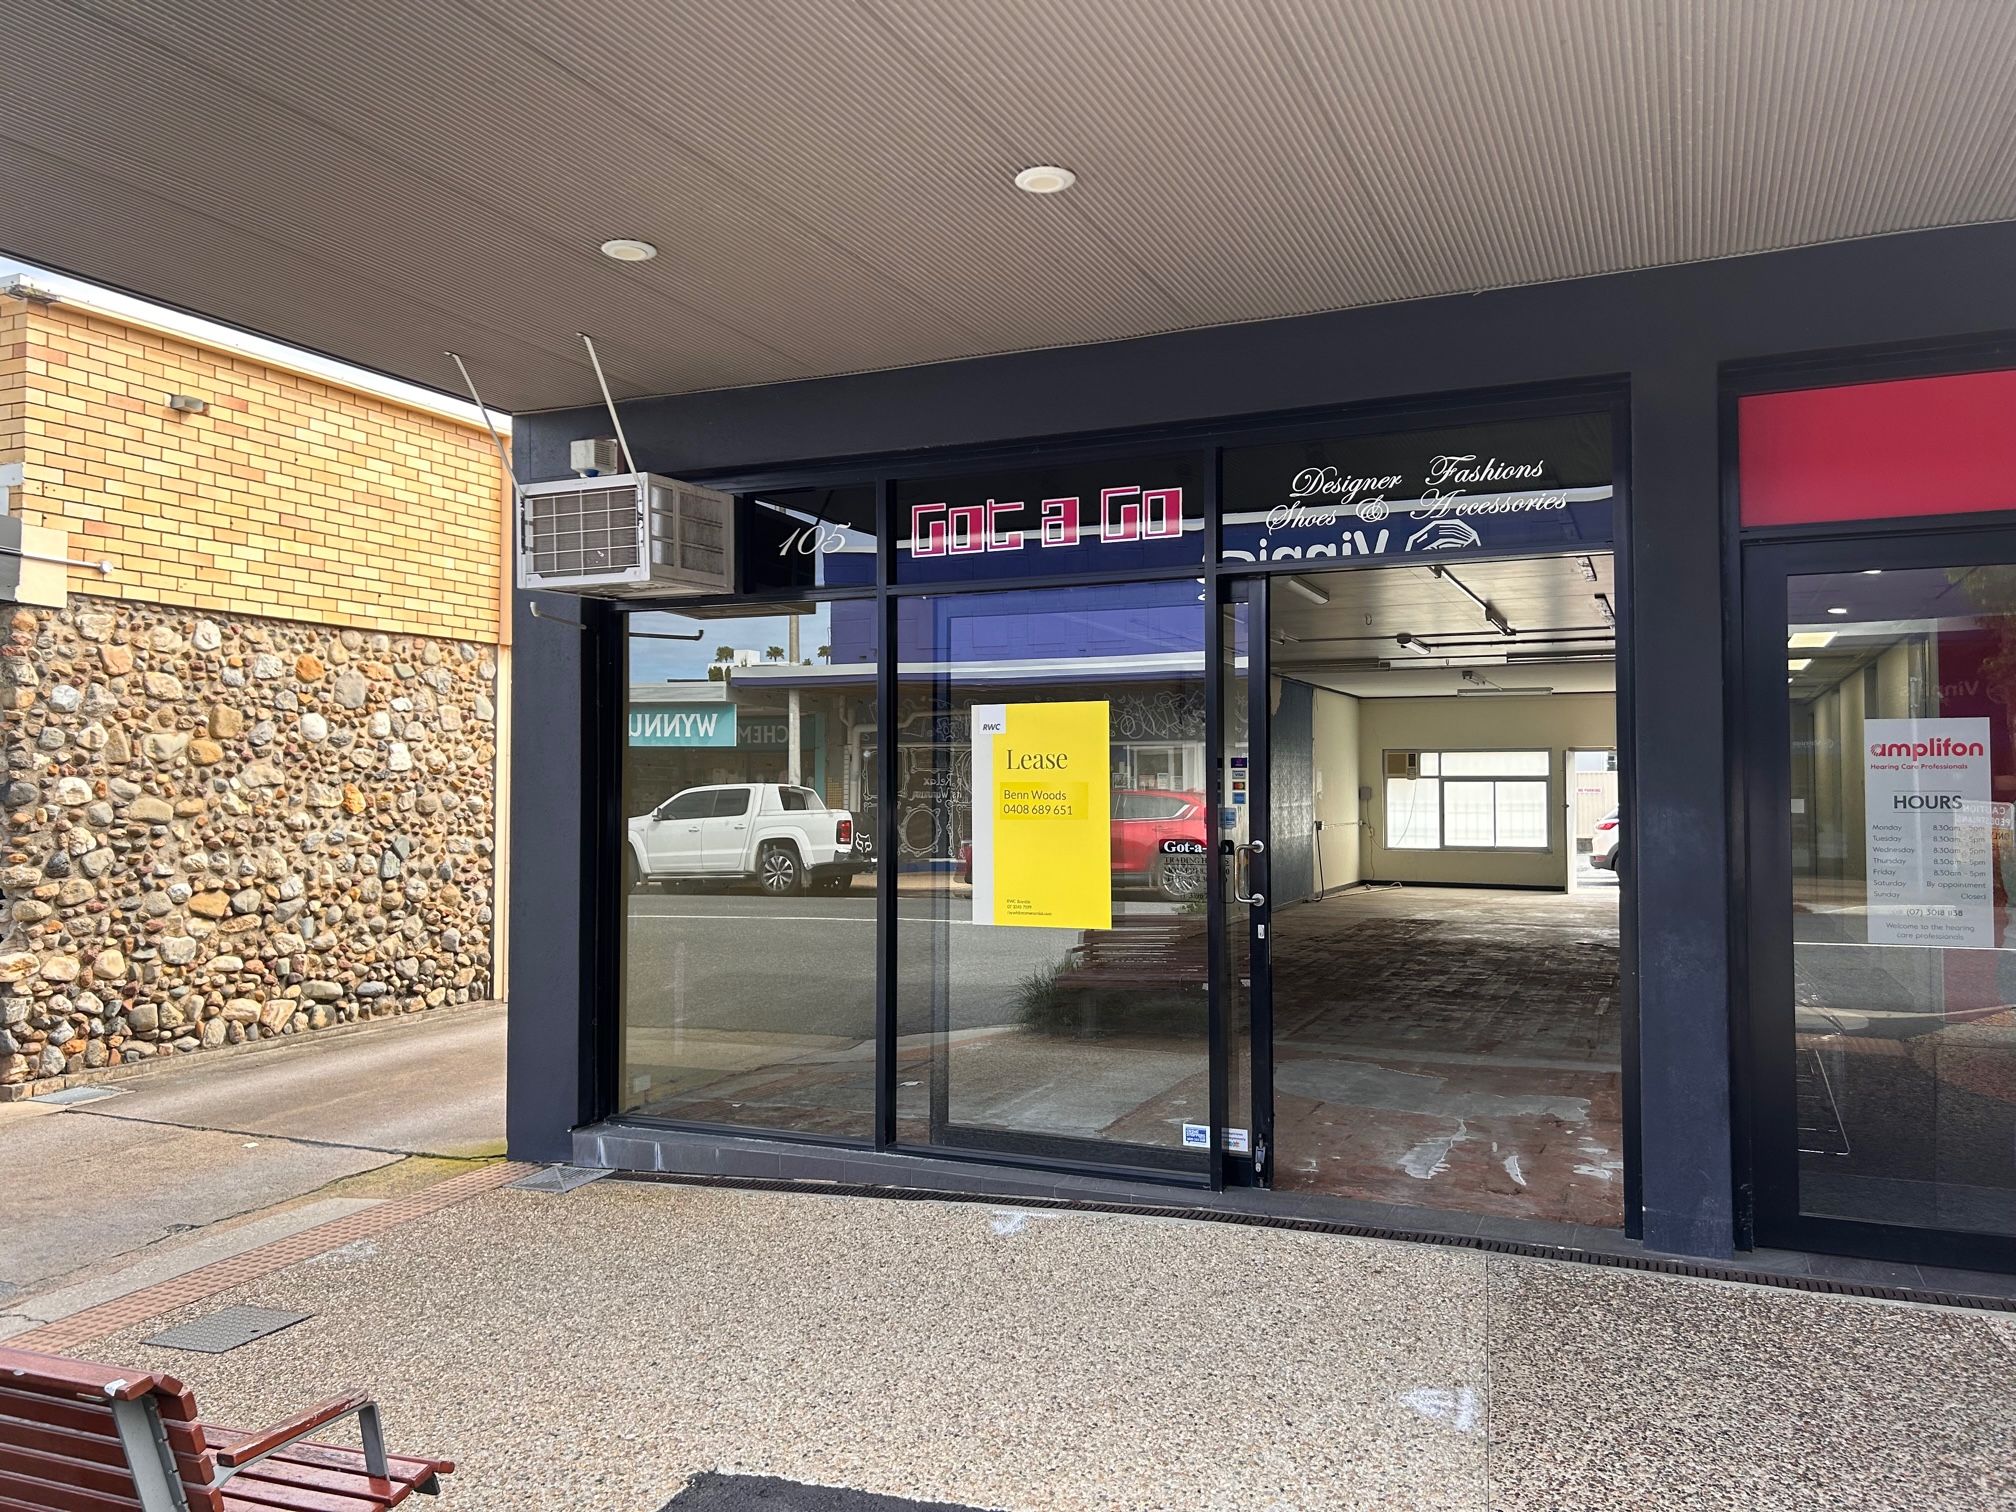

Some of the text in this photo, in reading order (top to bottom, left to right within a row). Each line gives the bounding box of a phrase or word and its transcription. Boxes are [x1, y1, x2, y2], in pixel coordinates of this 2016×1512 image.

[1289, 454, 1544, 504] Designer Fashions
[1266, 488, 1567, 535] Shoes & Accessories
[1041, 497, 1080, 547] a
[778, 521, 852, 556] 105
[982, 723, 1001, 731] RWC
[1870, 738, 1984, 762] amplifon
[1007, 750, 1068, 770] Lease
[1870, 763, 1899, 771] Hearing
[1004, 789, 1067, 800] Benn Woods
[1893, 795, 1963, 809] HOURS
[1003, 804, 1073, 816] 0408 689 651
[1872, 824, 1902, 832] Monday
[1872, 835, 1902, 843] Tuesday
[1872, 846, 1915, 854] Wednesday
[1969, 859, 1986, 867] 5pm
[1873, 868, 1897, 876] Friday
[1969, 870, 1986, 878] 5pm
[1873, 880, 1907, 888] Saturday
[1926, 881, 1986, 889] By appointment
[1873, 891, 1900, 899] Sunday
[1906, 908, 1923, 917] (07)
[1947, 909, 1964, 917] 1138
[1886, 922, 1919, 930] Welcome
[1931, 923, 1944, 931] the
[1945, 924, 1975, 933] hearing
[1915, 932, 1964, 940] professionals
